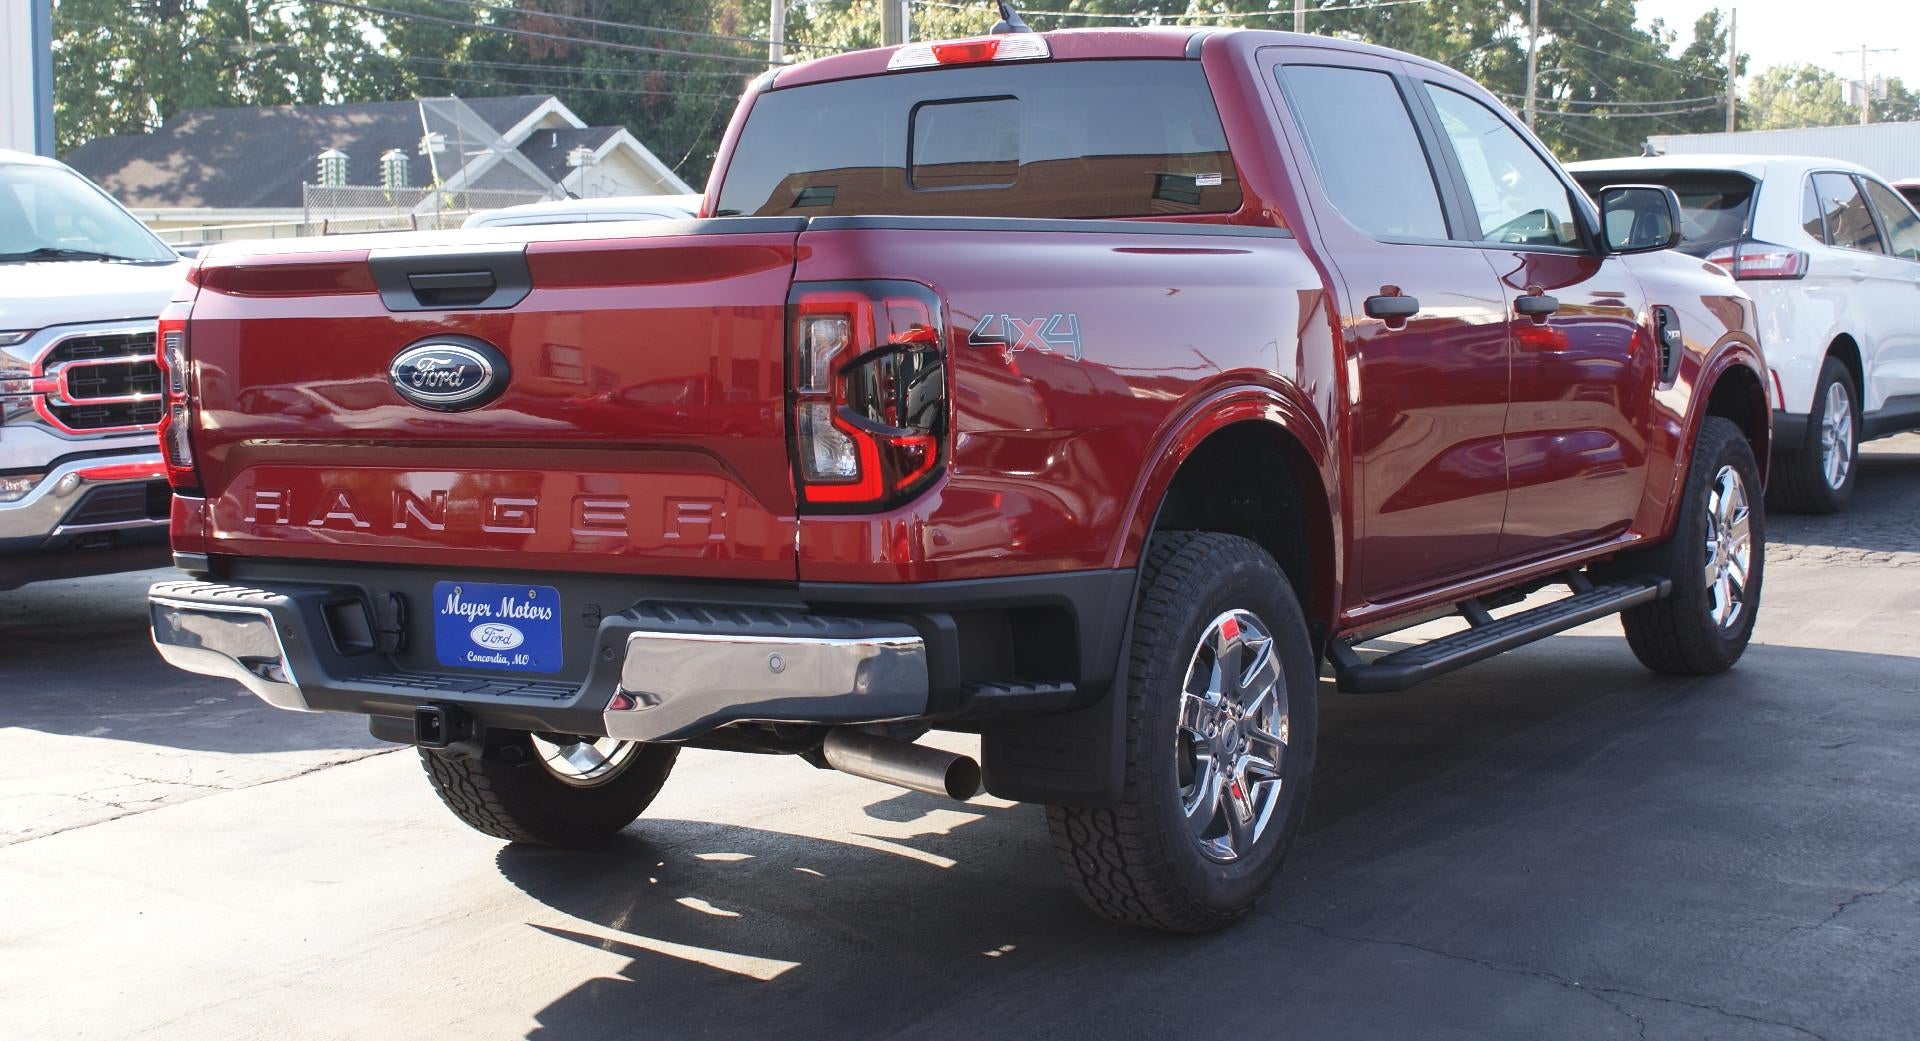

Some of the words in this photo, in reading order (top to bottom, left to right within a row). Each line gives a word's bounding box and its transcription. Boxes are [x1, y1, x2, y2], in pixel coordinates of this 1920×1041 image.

[967, 313, 1082, 364] 4x4
[411, 357, 466, 388] Ford
[243, 485, 727, 540] RANGER
[441, 593, 492, 623] Meyer
[495, 596, 552, 620] Motors
[481, 626, 513, 645] Ford
[467, 650, 511, 666] Concordia,
[511, 653, 530, 666] MO
